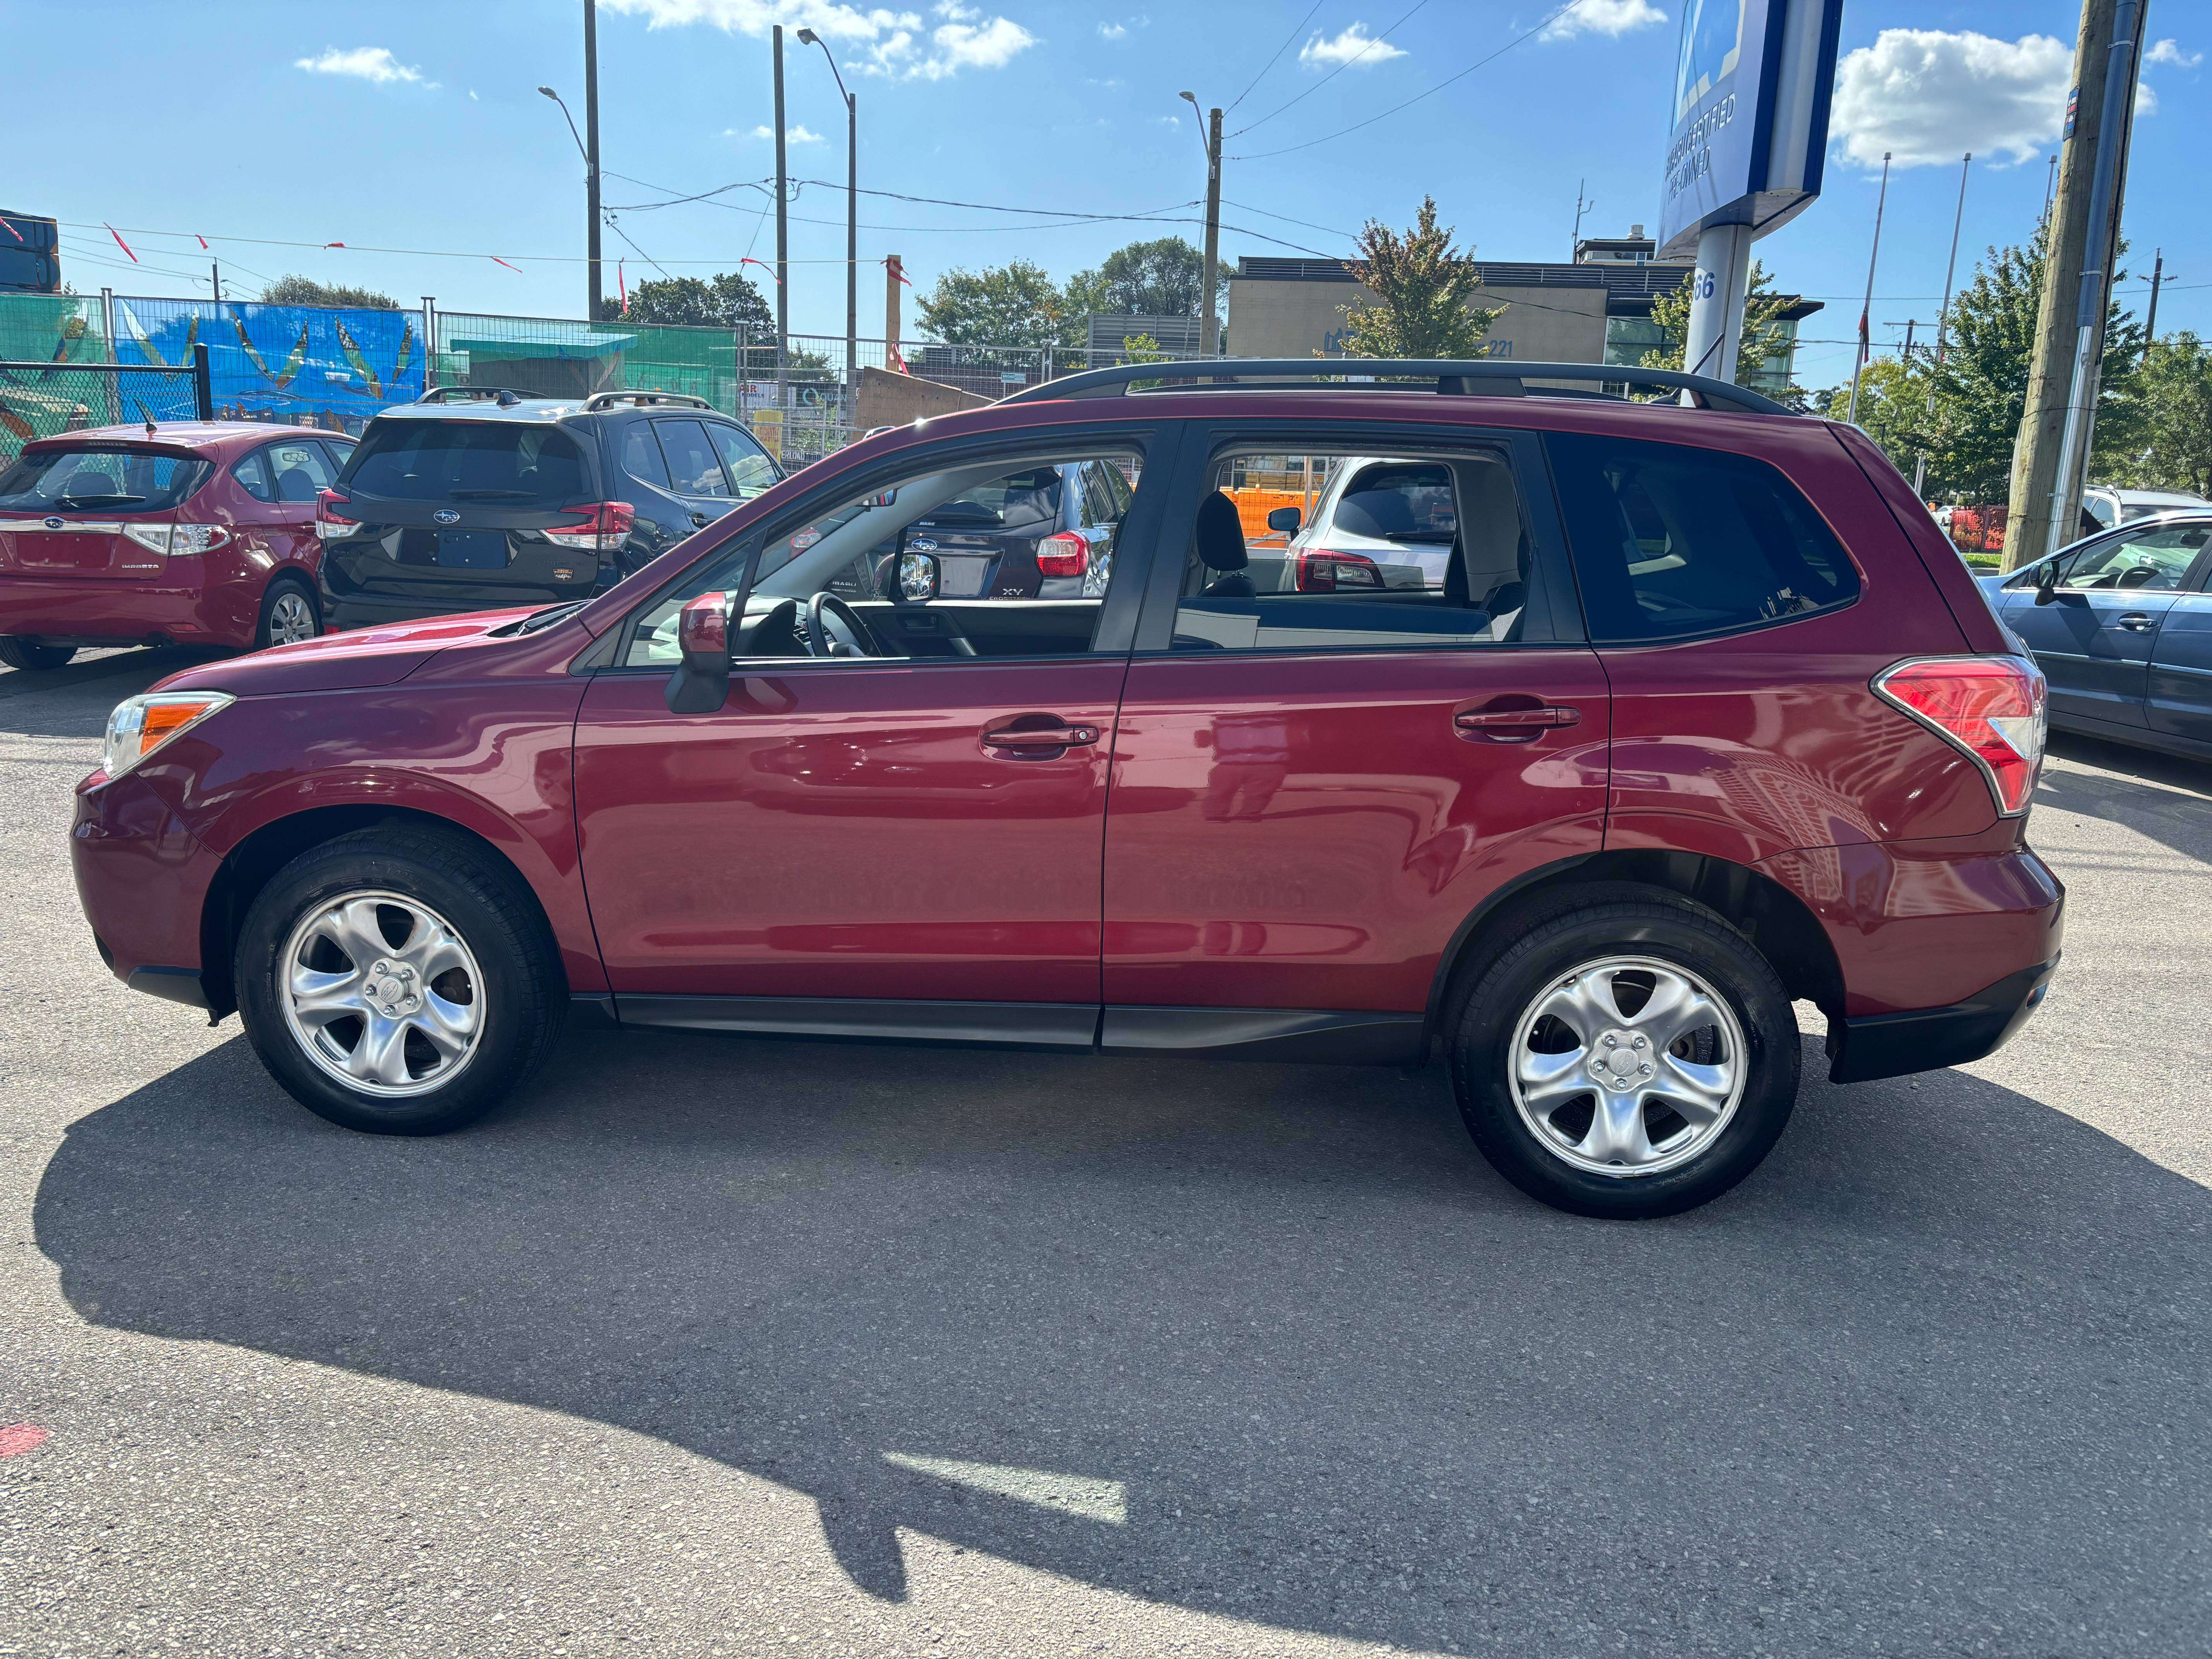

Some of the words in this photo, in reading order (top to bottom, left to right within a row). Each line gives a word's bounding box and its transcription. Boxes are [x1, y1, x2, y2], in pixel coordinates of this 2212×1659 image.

[1685, 92, 1735, 155] CERTIFIED
[1668, 145, 1711, 205] PRE-OWNED
[1488, 340, 1513, 357] 221
